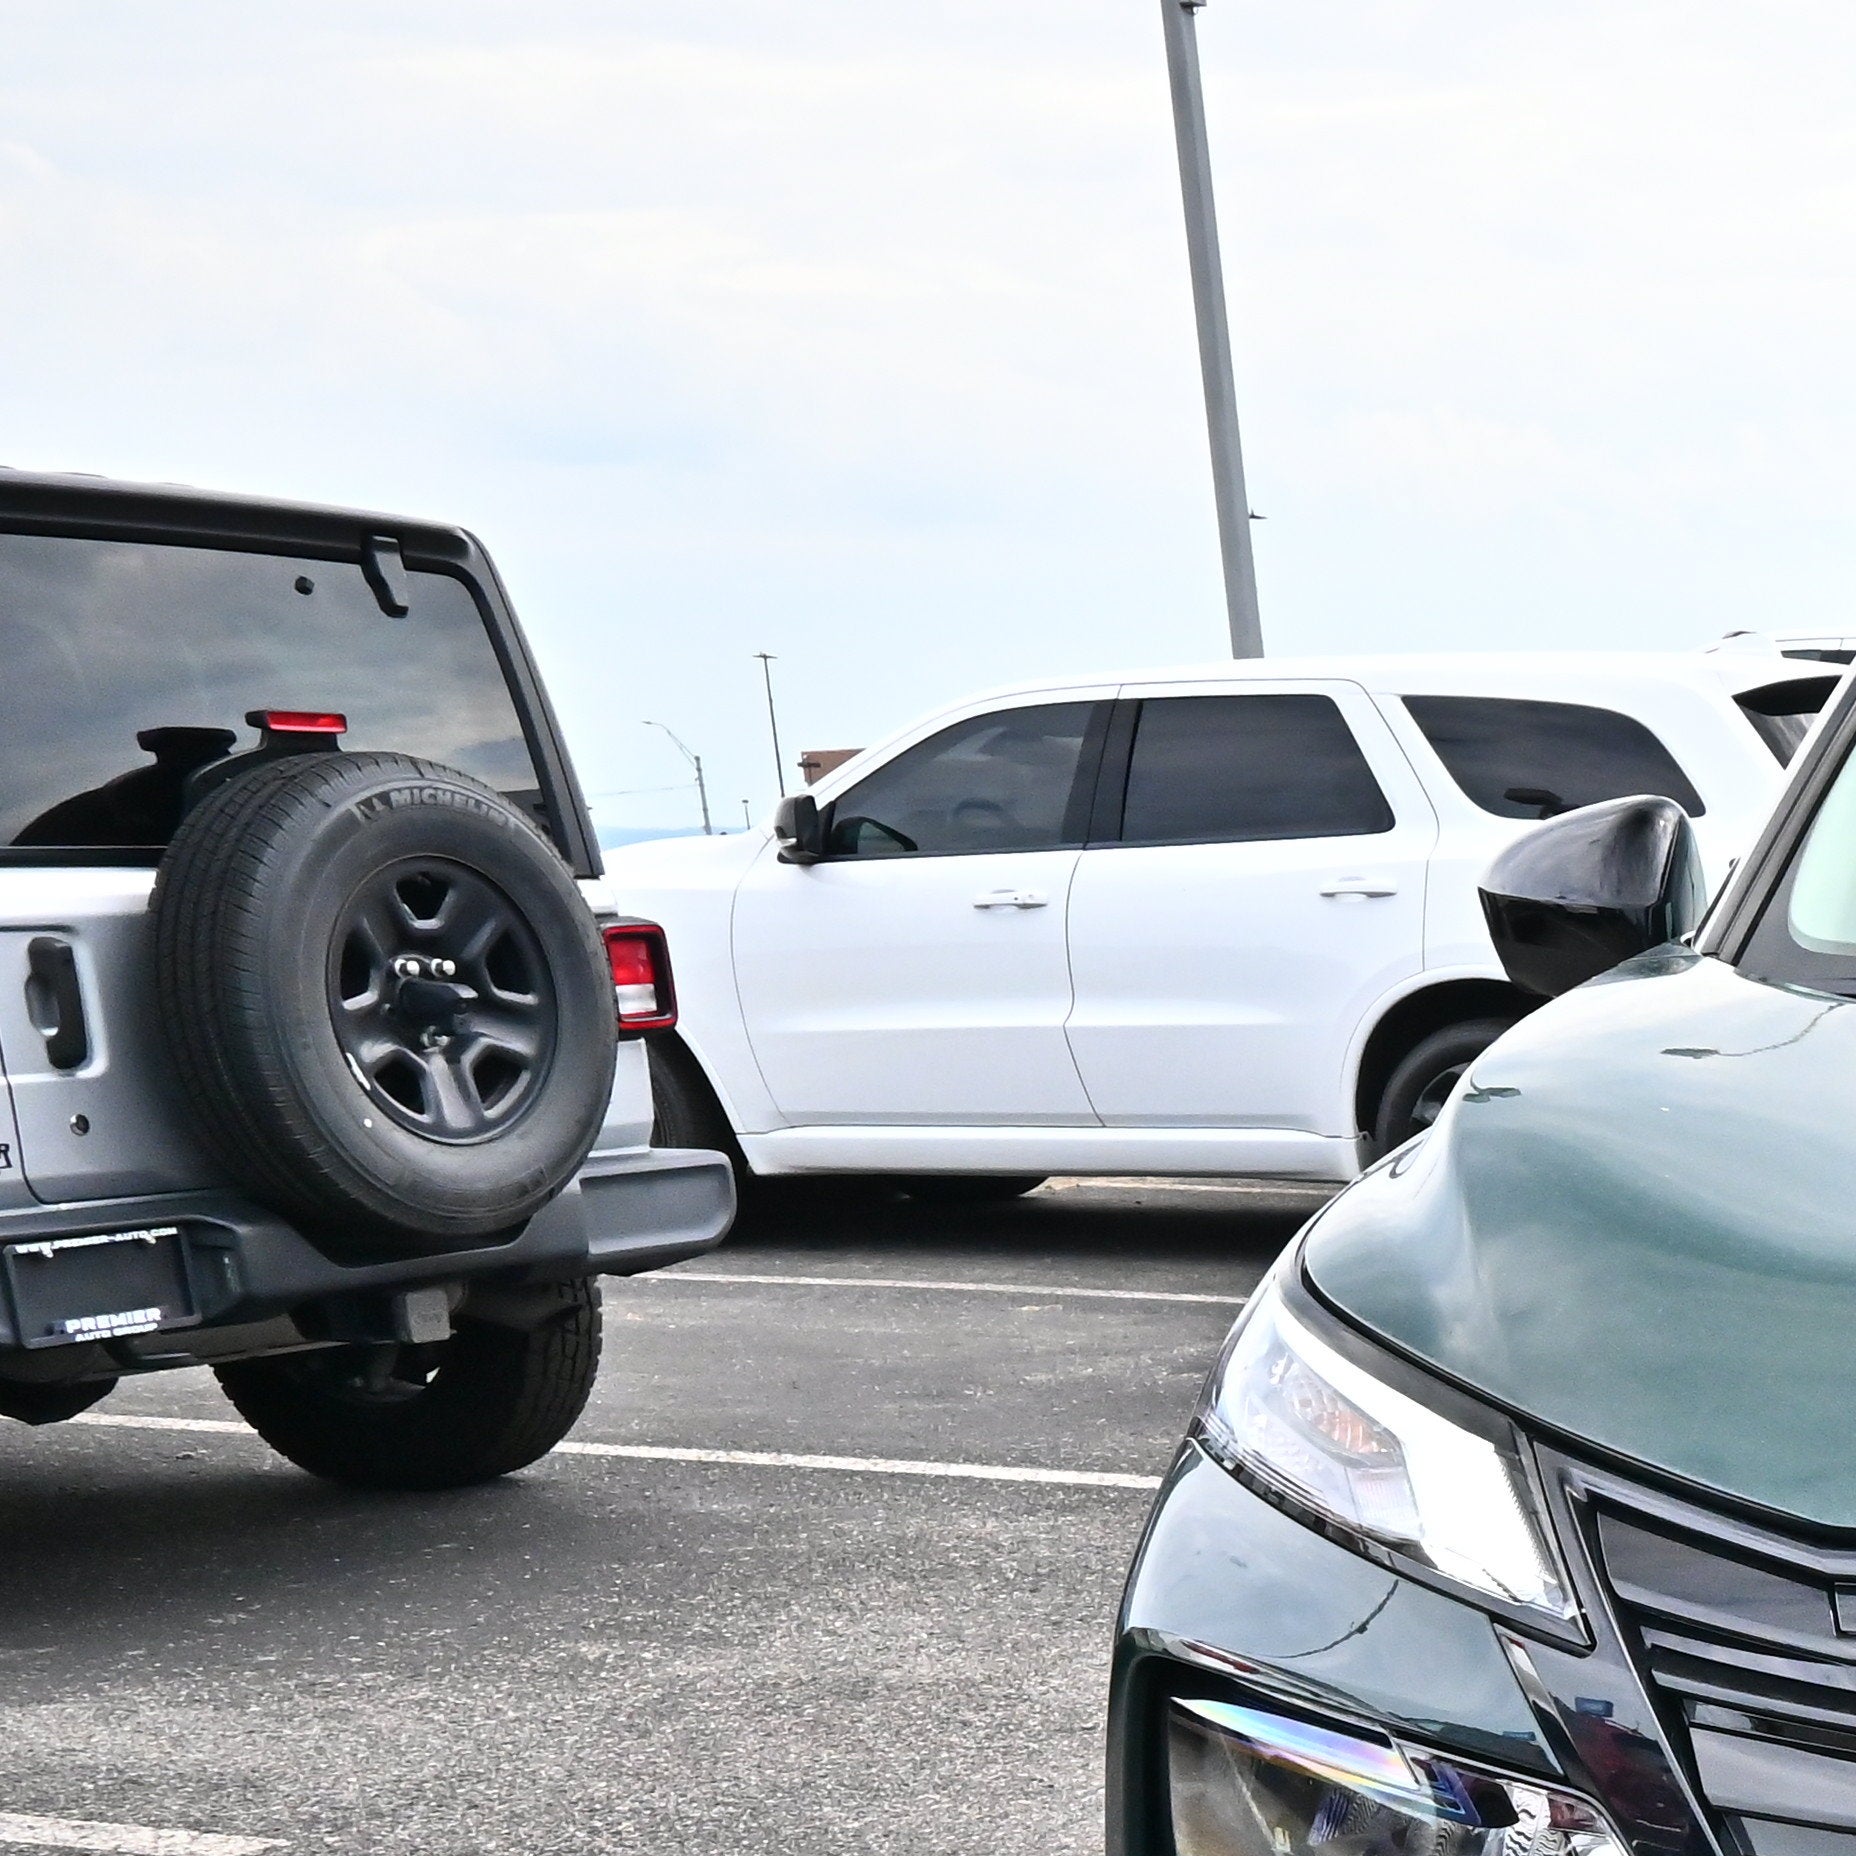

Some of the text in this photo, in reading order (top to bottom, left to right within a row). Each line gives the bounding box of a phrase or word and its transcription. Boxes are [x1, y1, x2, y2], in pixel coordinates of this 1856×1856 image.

[389, 786, 509, 829] MICHELIN
[64, 1307, 162, 1333] PREMIER
[75, 1329, 111, 1341] AUTO
